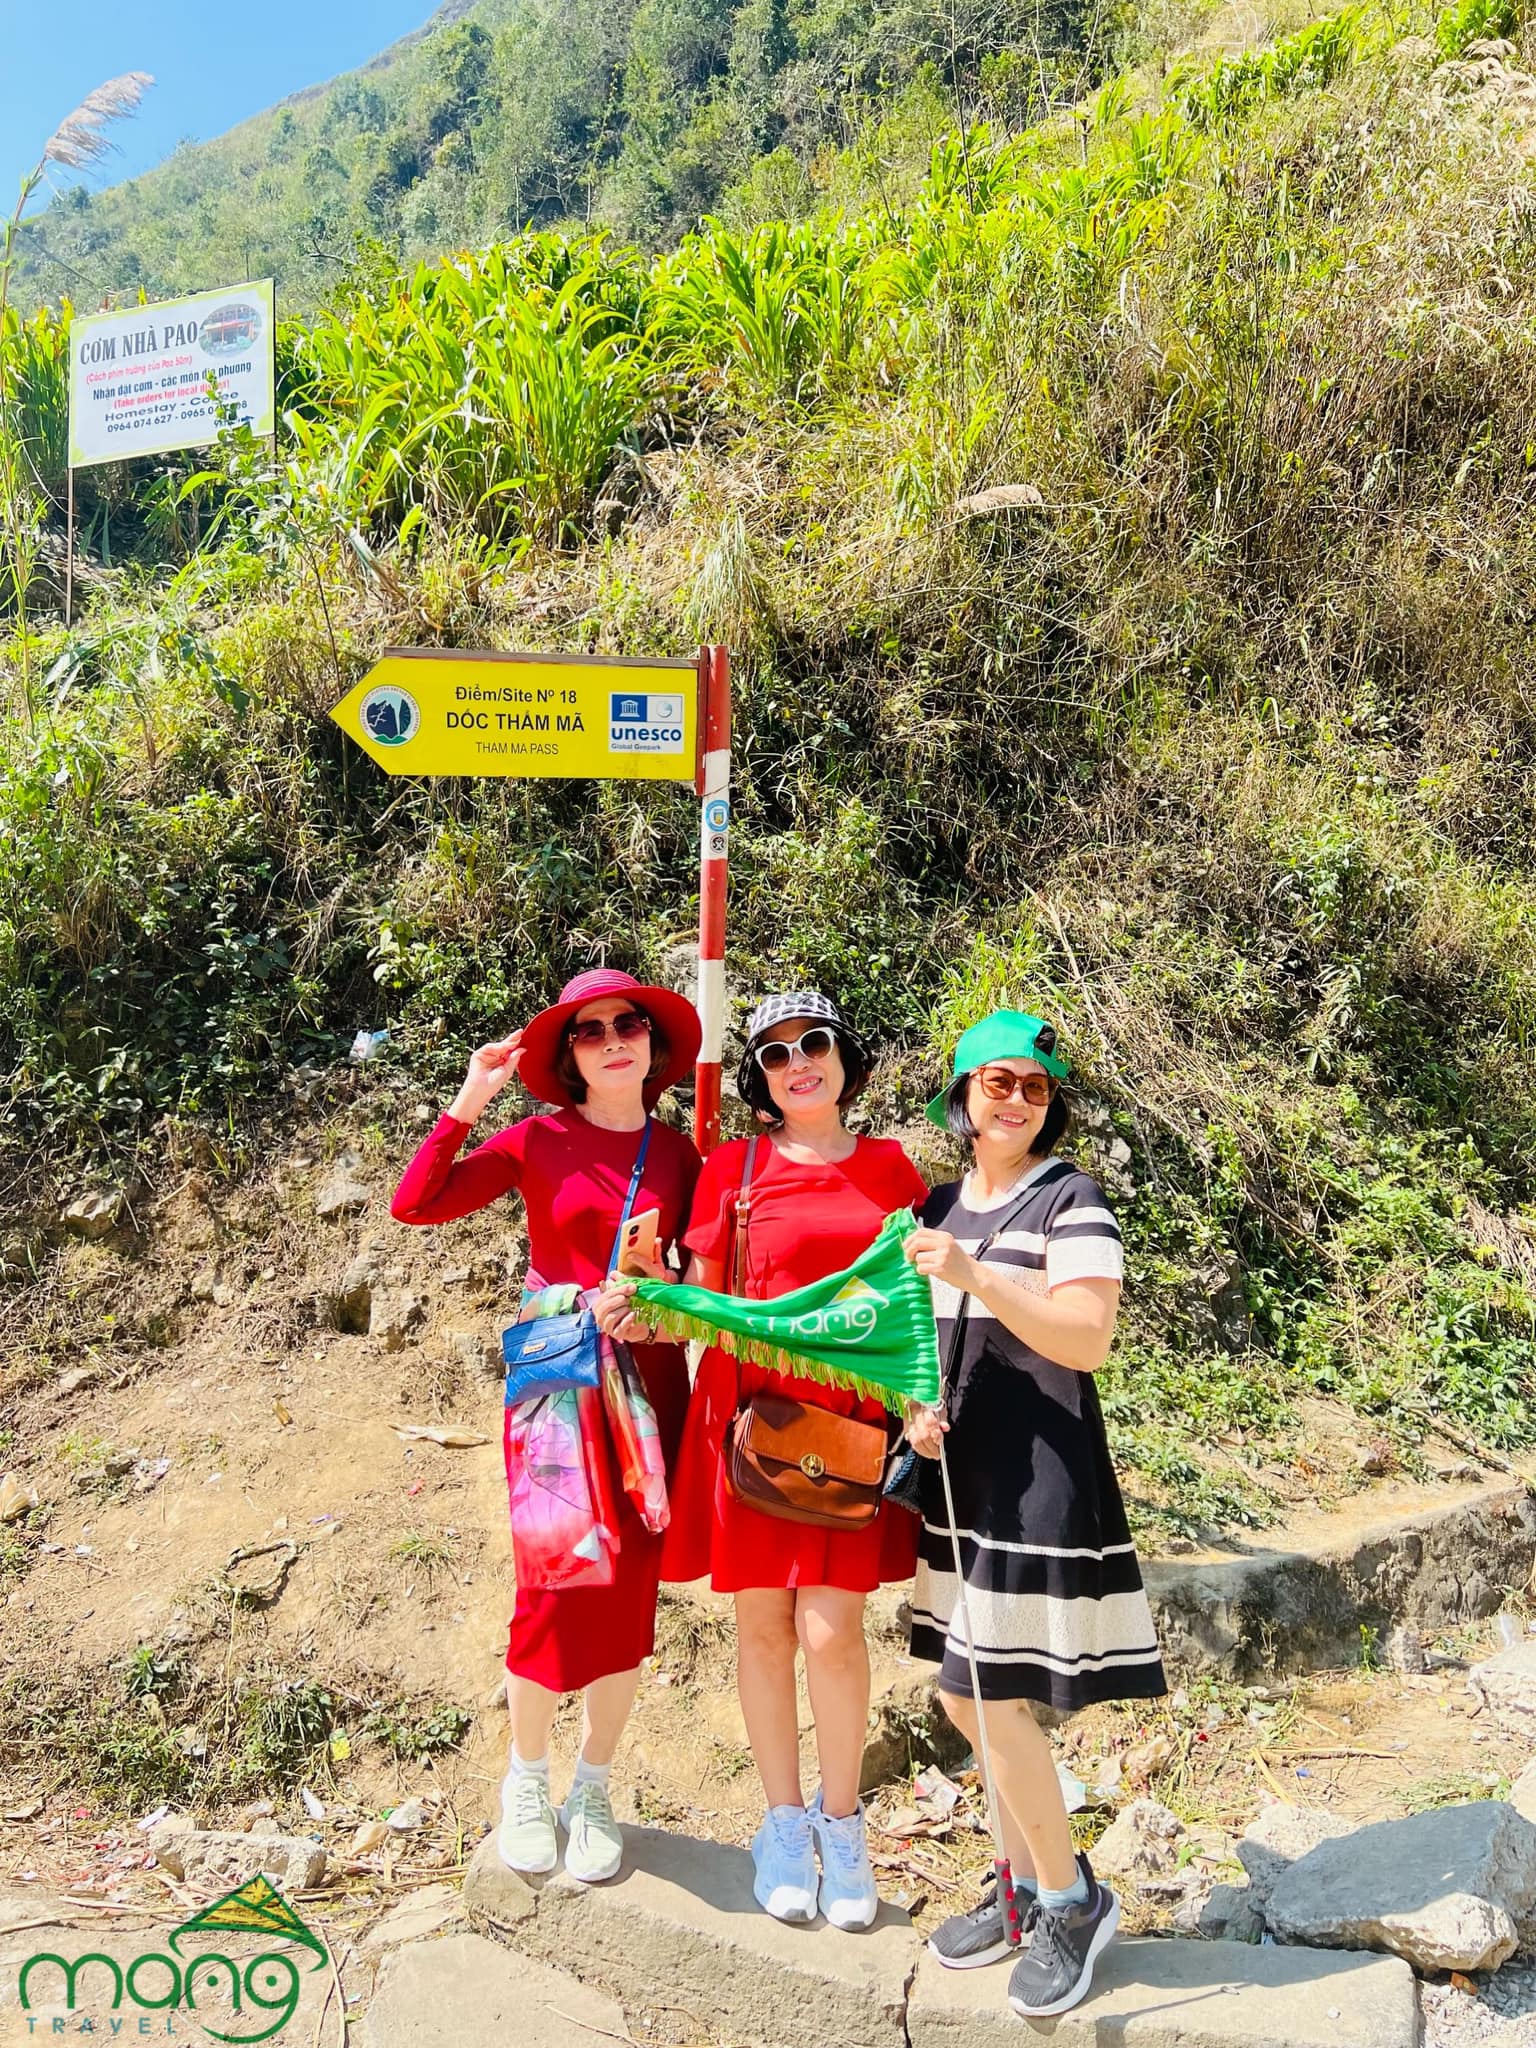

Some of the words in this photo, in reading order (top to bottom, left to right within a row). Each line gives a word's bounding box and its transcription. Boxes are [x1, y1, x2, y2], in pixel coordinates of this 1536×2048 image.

[80, 337, 116, 365] CƠM
[122, 325, 158, 357] NHÀ
[164, 320, 198, 349] PAO
[105, 402, 177, 421] Homestay
[107, 418, 131, 433] 0964
[133, 416, 152, 430] 074
[154, 413, 172, 426] 627
[181, 407, 205, 421] 0965
[456, 684, 533, 702] Điểm/Site
[560, 690, 577, 704] 18
[556, 712, 585, 732] MÃ
[611, 727, 682, 742] unesco
[476, 741, 508, 754] THAM
[511, 742, 527, 754] MA
[530, 743, 559, 755] PASS
